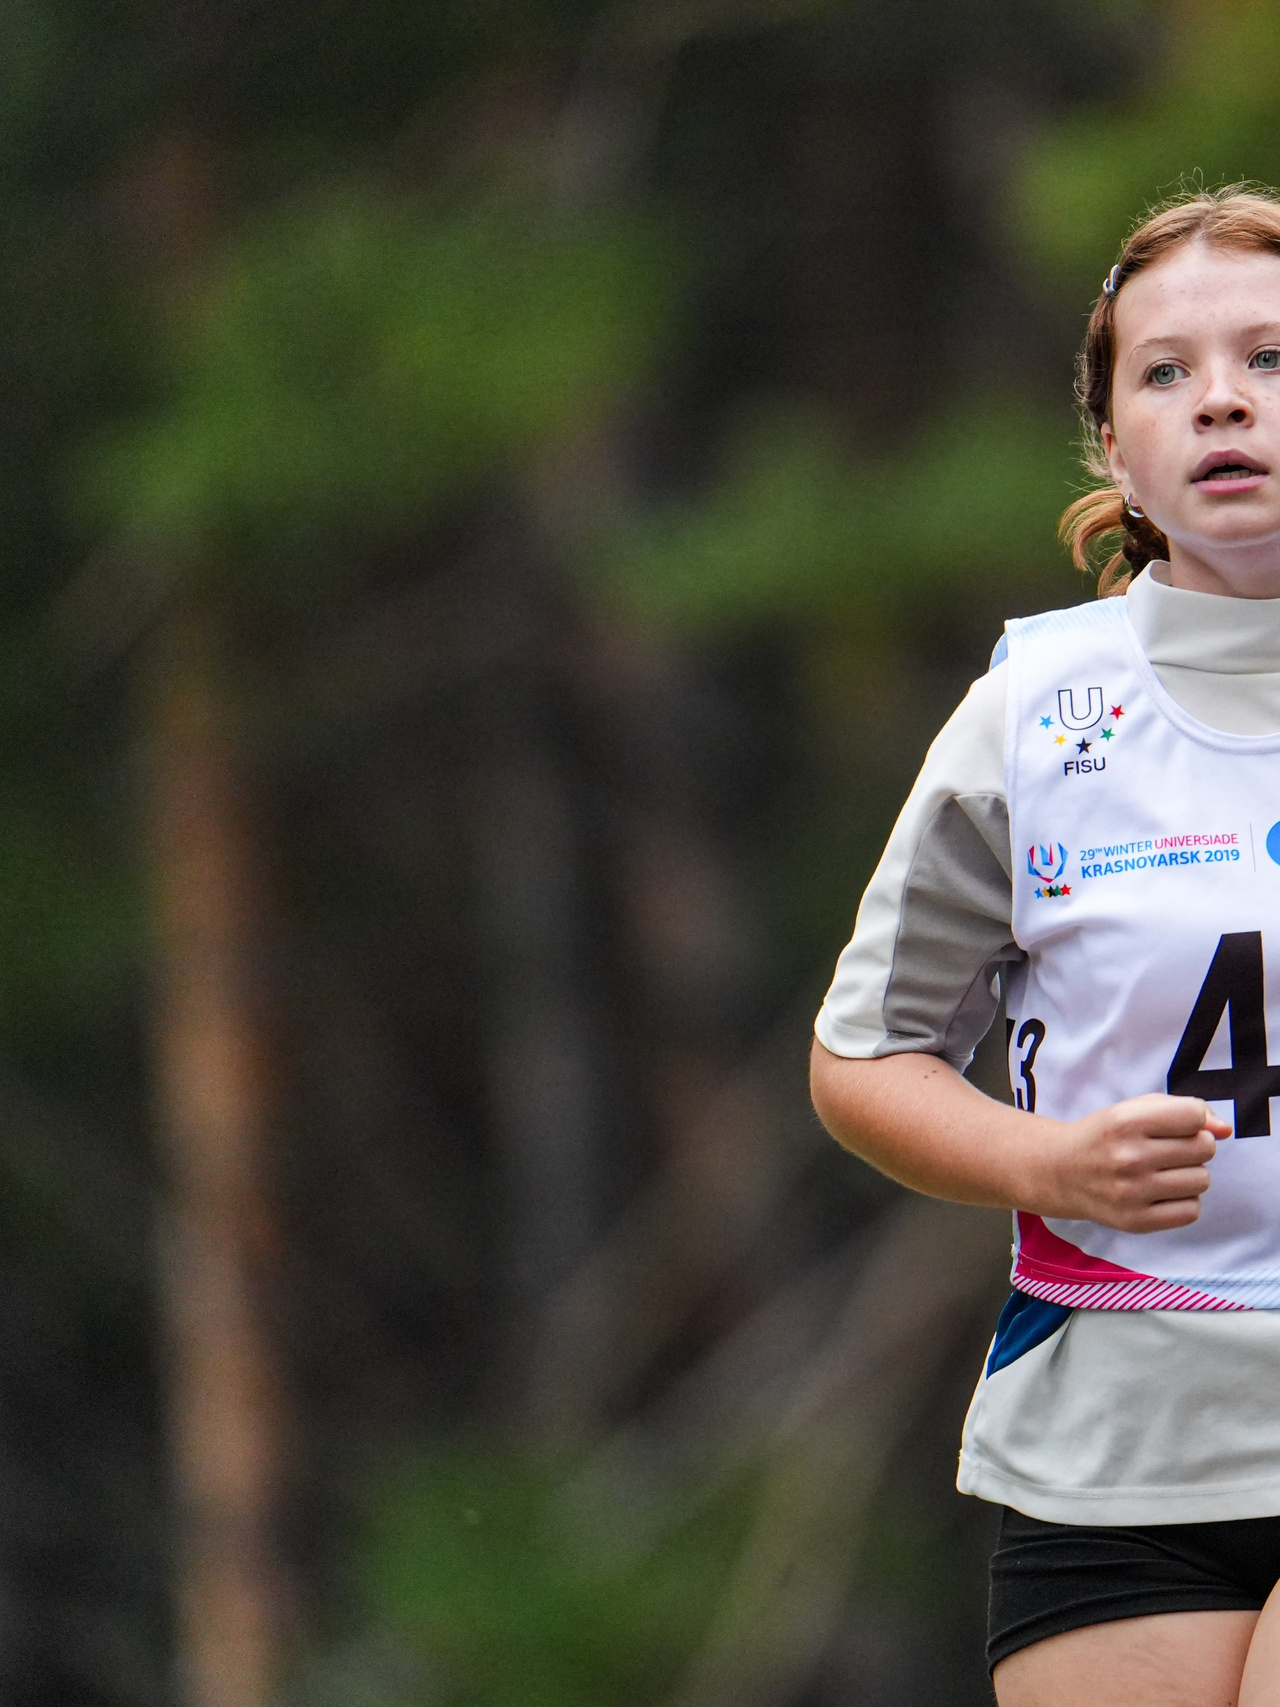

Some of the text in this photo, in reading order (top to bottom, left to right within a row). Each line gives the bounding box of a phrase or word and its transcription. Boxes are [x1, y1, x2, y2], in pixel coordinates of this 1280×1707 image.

[1063, 757, 1107, 776] FISU
[1103, 840, 1152, 857] WINTER
[1154, 833, 1239, 850] UNIVERSIADE
[1081, 849, 1240, 879] KRASNOYARSK 2019
[1006, 1018, 1046, 1113] 3
